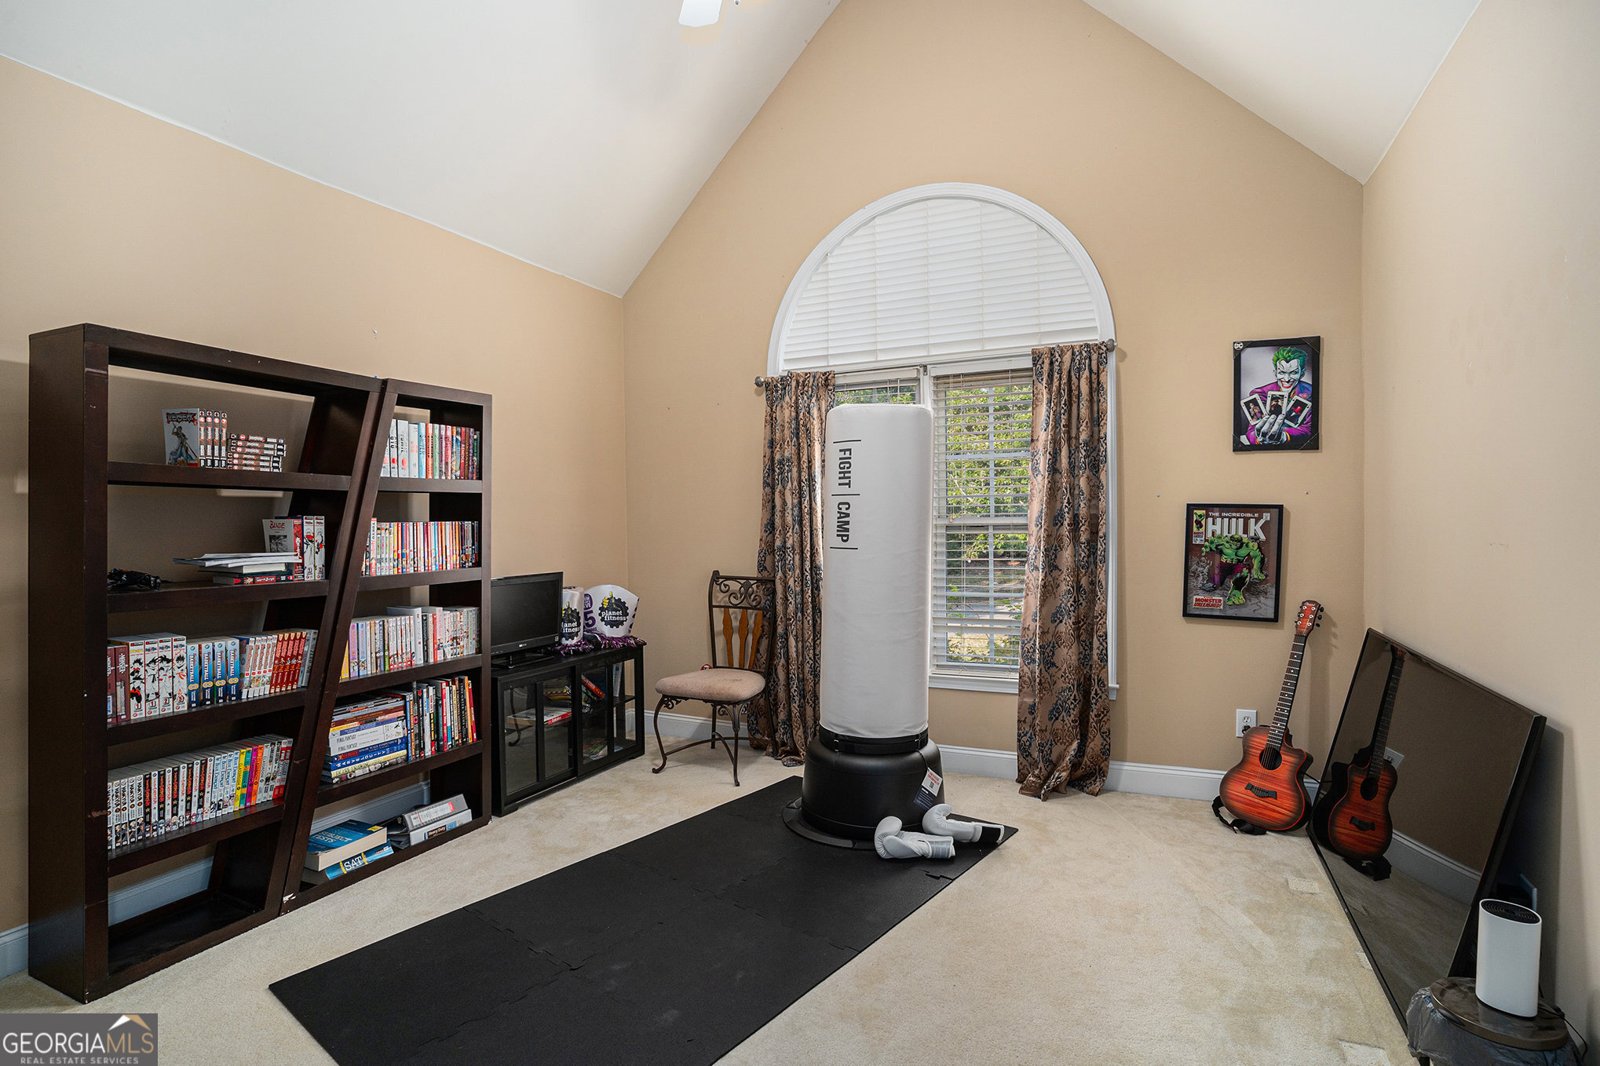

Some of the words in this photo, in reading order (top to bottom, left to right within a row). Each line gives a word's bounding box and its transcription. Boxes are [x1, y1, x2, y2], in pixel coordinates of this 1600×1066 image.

[838, 448, 852, 488] FIGHT
[836, 502, 851, 543] CAMP
[1206, 517, 1266, 541] HULK
[343, 855, 363, 871] SAT
